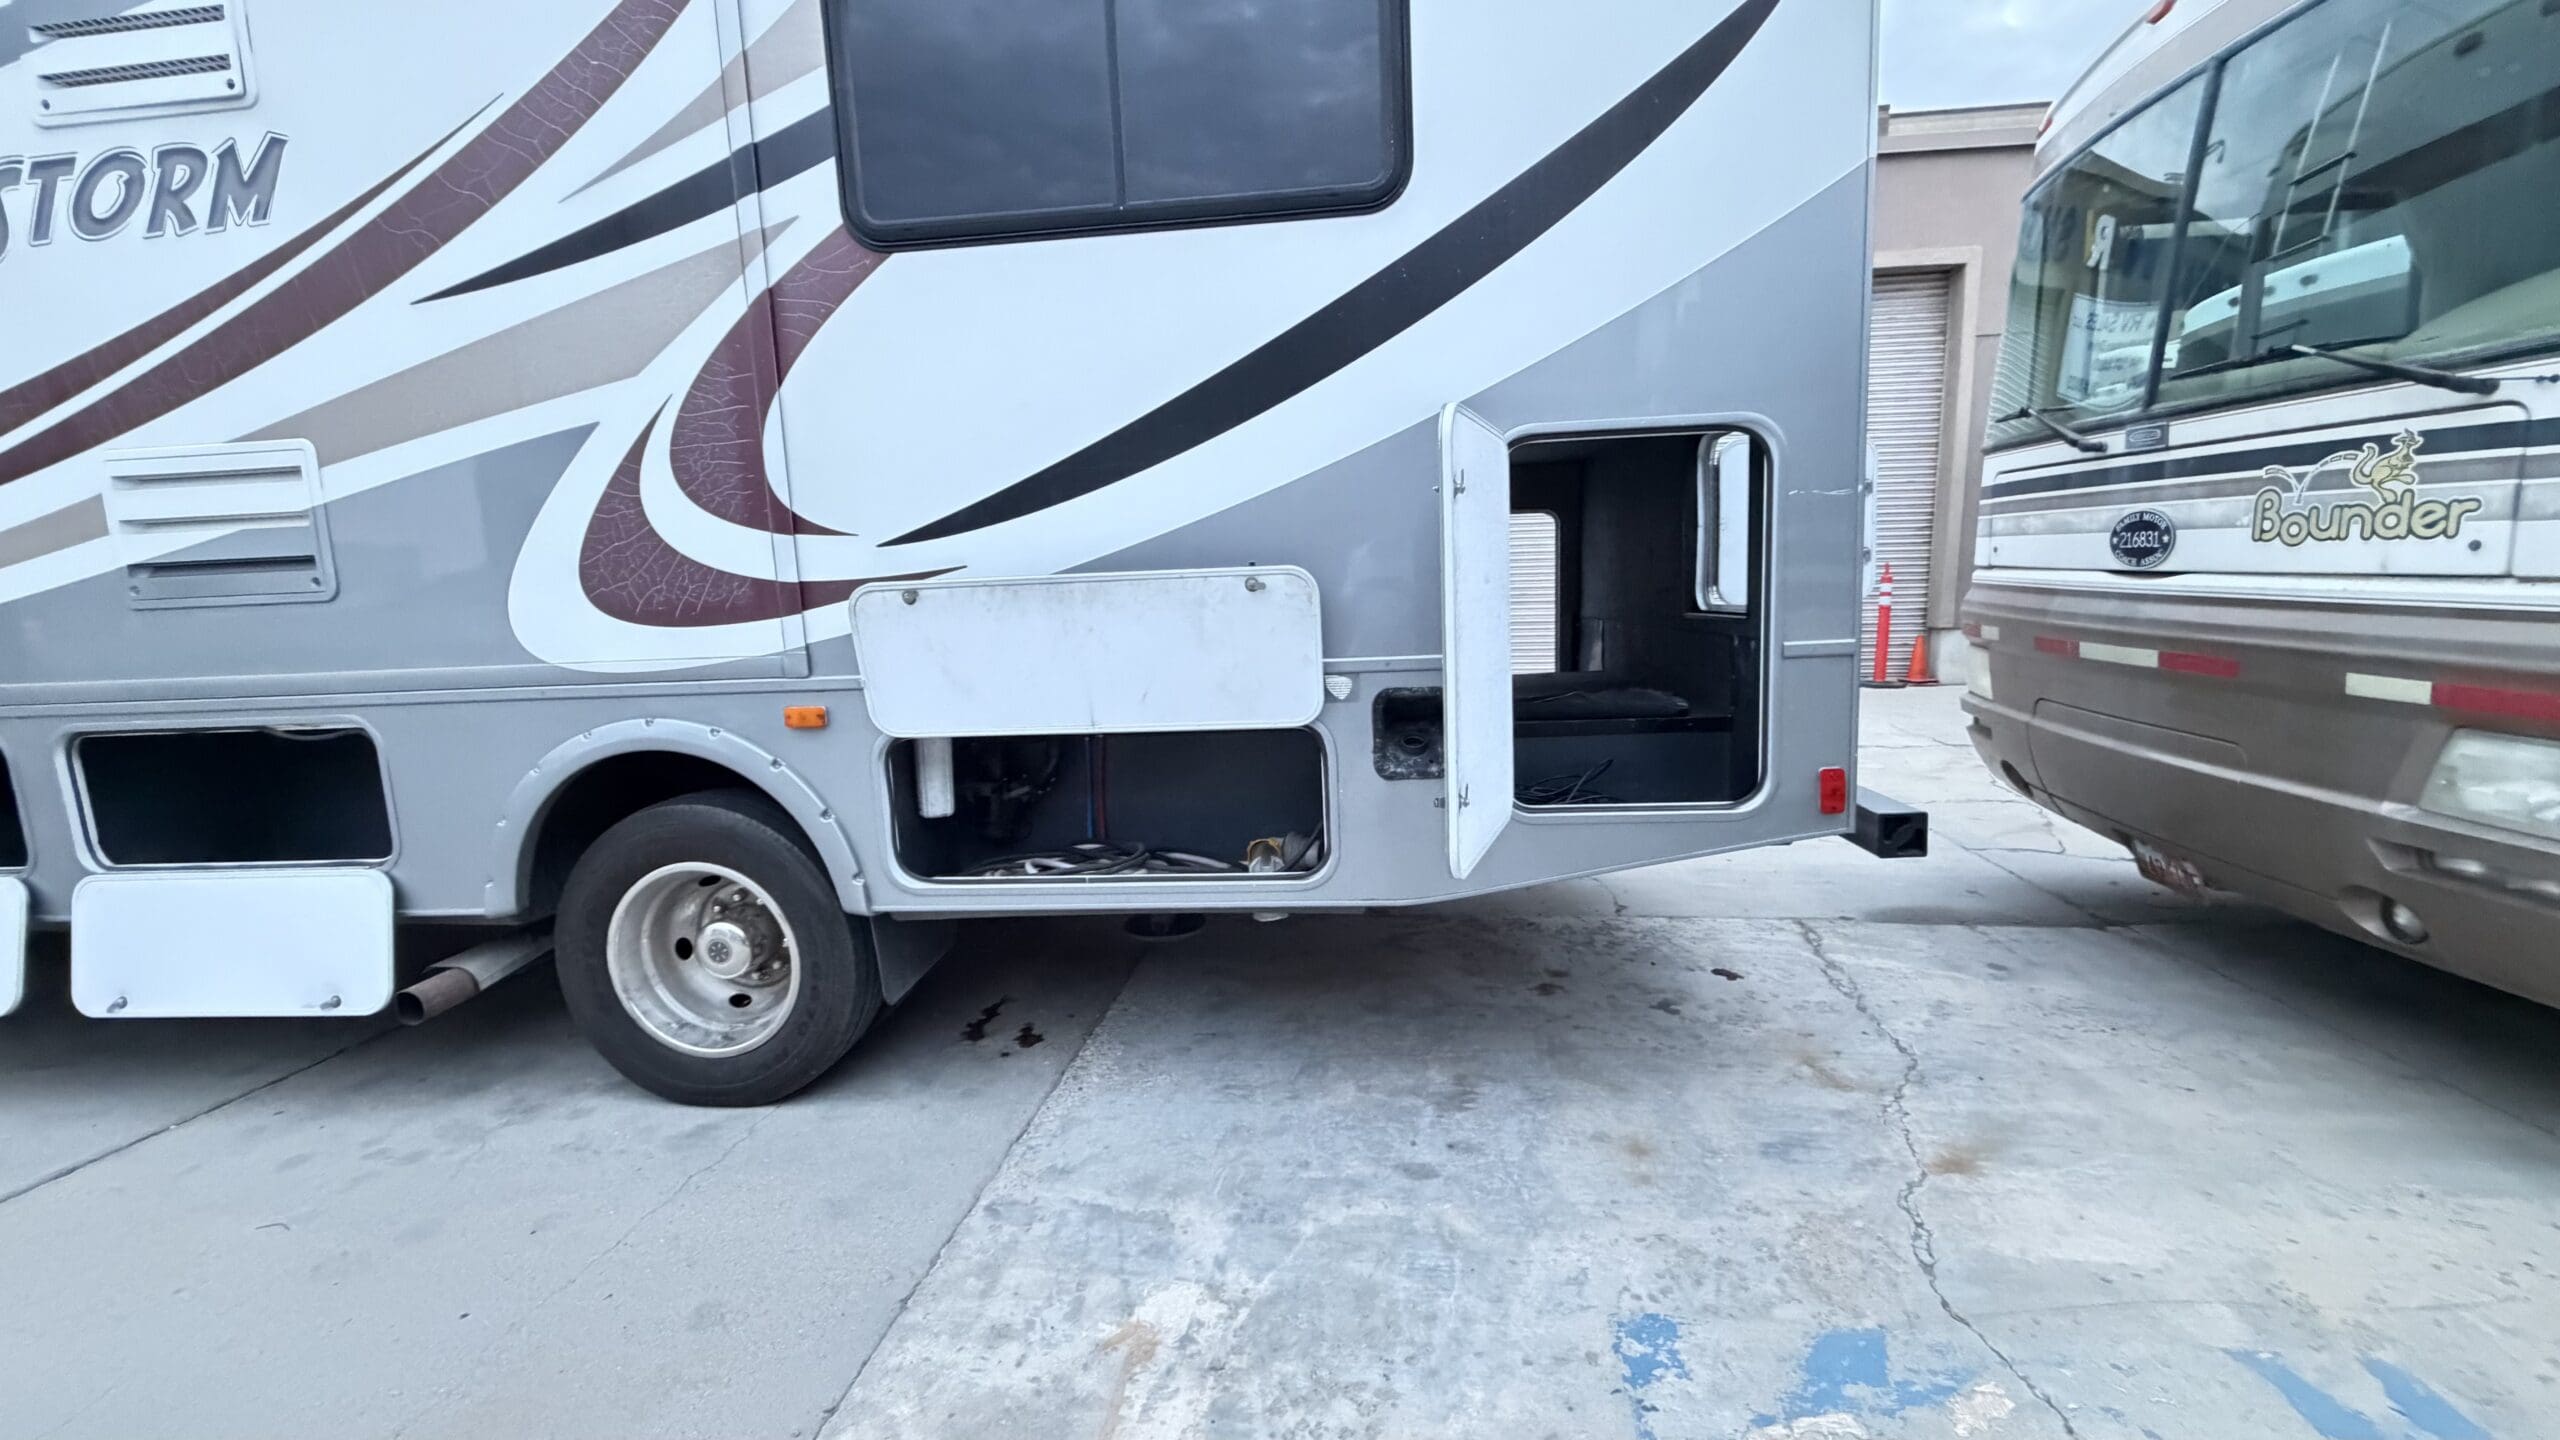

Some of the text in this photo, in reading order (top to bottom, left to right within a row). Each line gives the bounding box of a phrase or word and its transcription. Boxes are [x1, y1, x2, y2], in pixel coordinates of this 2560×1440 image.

[2116, 513, 2166, 532] FAMILY MOTOR
[2253, 488, 2482, 547] Bounder
[2119, 531, 2161, 548] 216831
